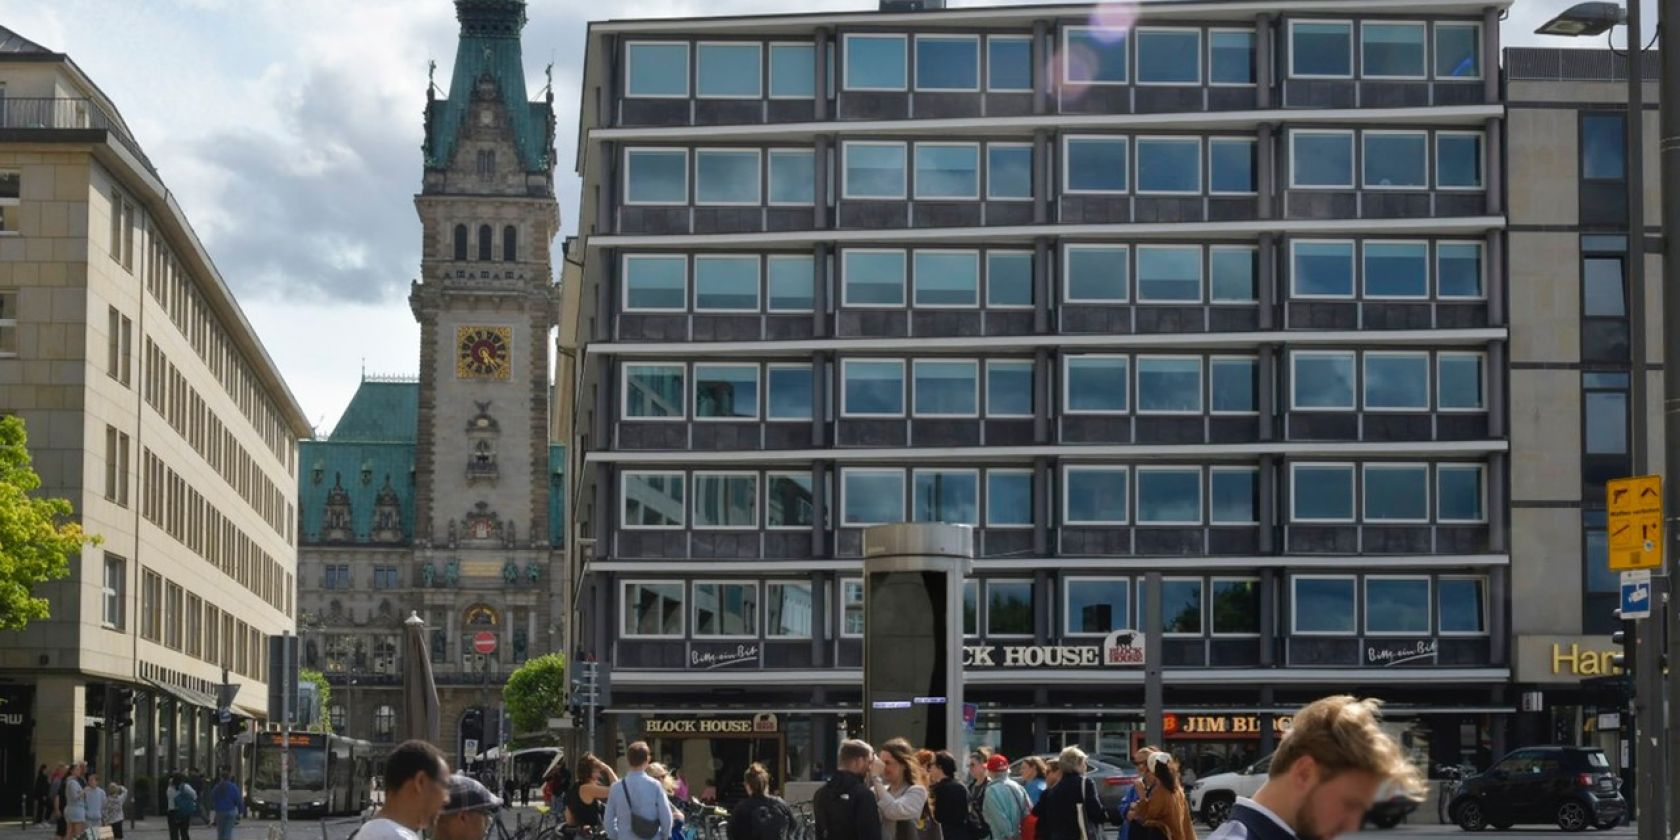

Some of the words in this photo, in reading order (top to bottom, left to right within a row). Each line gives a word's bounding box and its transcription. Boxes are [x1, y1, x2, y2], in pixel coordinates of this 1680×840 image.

[1003, 646, 1099, 666] HOUSE
[646, 719, 696, 732] BLOCK
[700, 719, 752, 732] HOUSE
[1183, 717, 1226, 732] JIM
